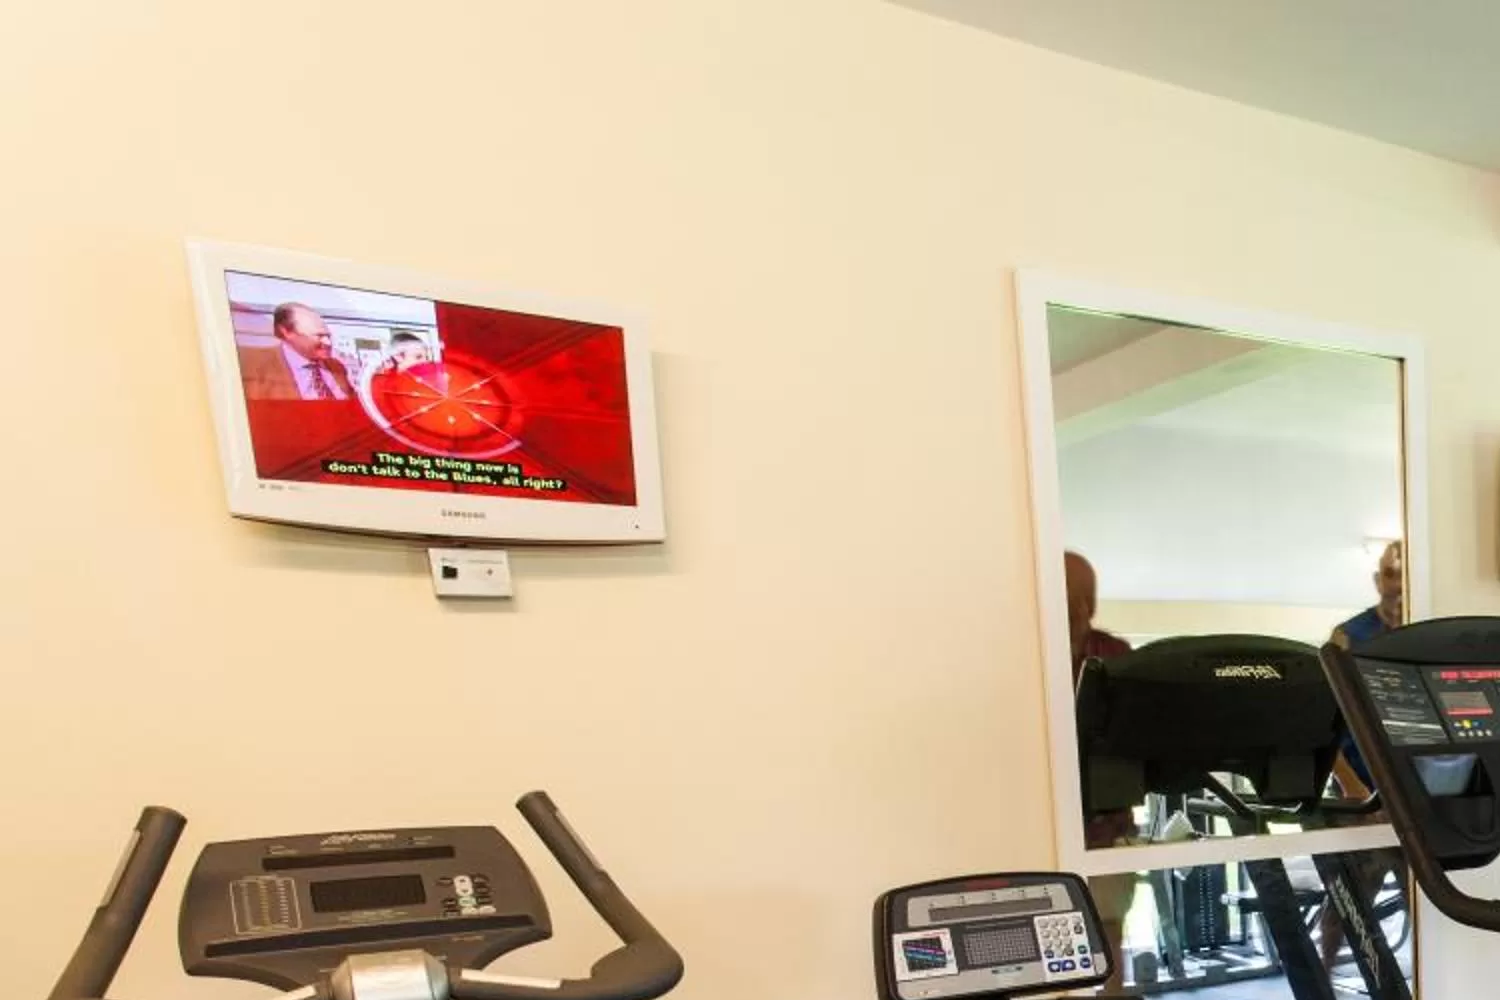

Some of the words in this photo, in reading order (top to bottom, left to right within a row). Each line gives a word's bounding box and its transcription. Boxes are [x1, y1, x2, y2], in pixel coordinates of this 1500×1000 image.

[376, 453, 404, 465] The
[408, 456, 431, 469] big
[435, 458, 472, 472] thing
[475, 462, 503, 474] now
[507, 463, 520, 474] is
[328, 462, 369, 475] don't
[372, 464, 401, 477] talk
[405, 467, 421, 479] to
[425, 468, 448, 481] the
[502, 475, 520, 487] all
[523, 477, 563, 491] right?
